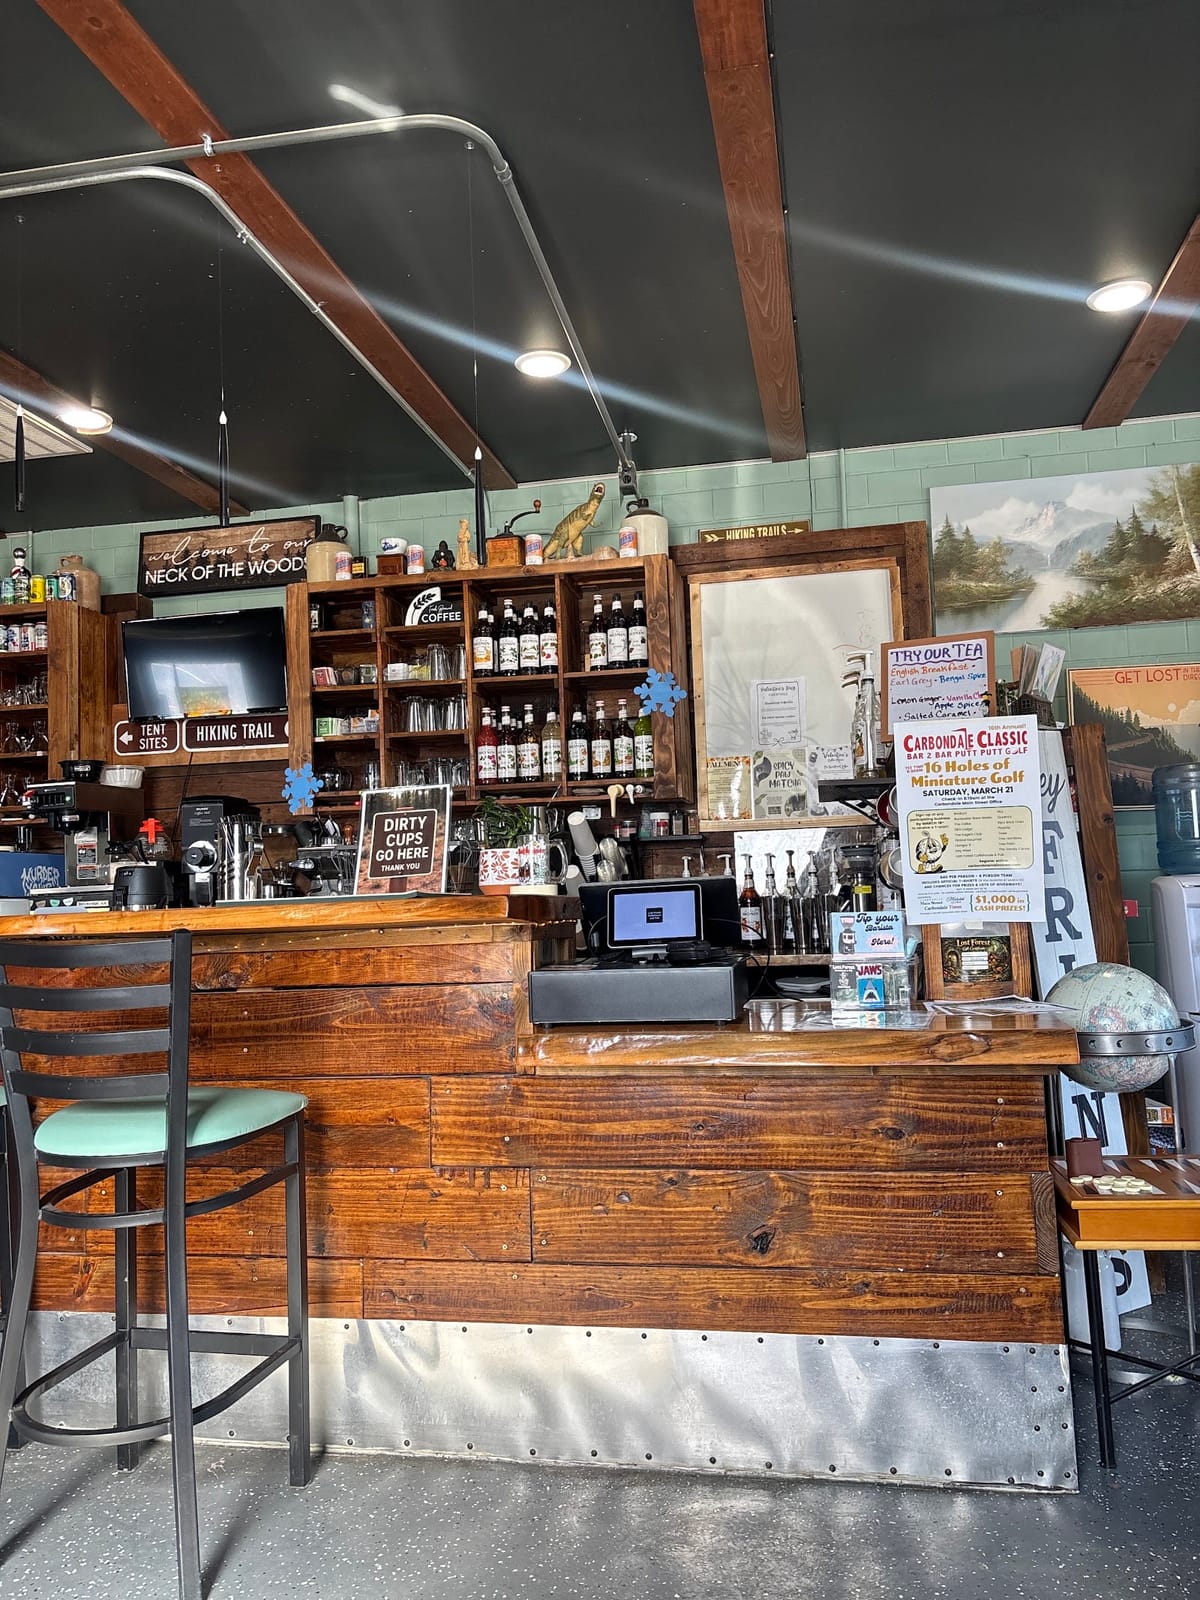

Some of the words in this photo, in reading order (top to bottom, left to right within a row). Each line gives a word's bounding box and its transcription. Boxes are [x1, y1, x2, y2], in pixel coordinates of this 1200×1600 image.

[726, 529, 755, 541] HIKING
[757, 525, 787, 538] TRAILS
[149, 535, 238, 566] welcome
[242, 526, 275, 554] to
[284, 538, 312, 551] our
[145, 567, 190, 585] NECK
[191, 565, 215, 581] OF
[214, 562, 244, 578] THE
[421, 611, 461, 623] COFFEE
[890, 650, 921, 662] TRY
[924, 647, 951, 660] OUR
[952, 643, 983, 657] TEA
[890, 666, 919, 678] English
[922, 663, 968, 674] Breakfast
[1114, 670, 1141, 684] GET
[1146, 668, 1181, 682] LOST
[890, 678, 909, 687] Earl
[912, 678, 933, 687] Grey
[891, 696, 917, 705] Lemon
[934, 701, 955, 710] Apple
[957, 701, 981, 709] Spice
[903, 711, 934, 721] Salted
[935, 709, 971, 718] Caramel
[140, 723, 167, 736] TENT
[196, 724, 238, 742] HIKING
[242, 722, 275, 740] TRAIL
[139, 736, 168, 750] SITES
[903, 728, 974, 753] CARBONDALE
[977, 730, 1028, 749] CLASSIC
[907, 752, 924, 760] BAR
[935, 751, 952, 759] BAR
[955, 749, 977, 758] PUTT
[980, 748, 1002, 756] PUTT
[1005, 746, 1028, 755] GOLF
[773, 760, 795, 770] SPICY
[924, 761, 941, 774] 16
[945, 759, 990, 773] Holes
[992, 757, 1010, 770] of
[775, 771, 791, 779] PAW
[911, 774, 987, 788] Miniature
[991, 770, 1025, 784] Golf
[768, 779, 802, 788] MATCHA
[922, 788, 970, 797] SATURDAY,
[971, 787, 1004, 795] MARCH
[384, 816, 428, 832] DIRTY
[386, 832, 423, 847] CUPS
[375, 849, 394, 861] GO
[397, 846, 429, 860] HERE
[20, 865, 60, 882] MURDER
[381, 863, 404, 872] THANK
[406, 862, 421, 870] YOU
[975, 894, 1016, 904] $1,000
[996, 904, 1026, 912] PRIZES!
[856, 912, 872, 924] Tip
[875, 914, 899, 925] your
[865, 924, 894, 932] Barista
[870, 937, 895, 946] Here!
[970, 938, 991, 946] Forest
[857, 965, 882, 976] JAWS
